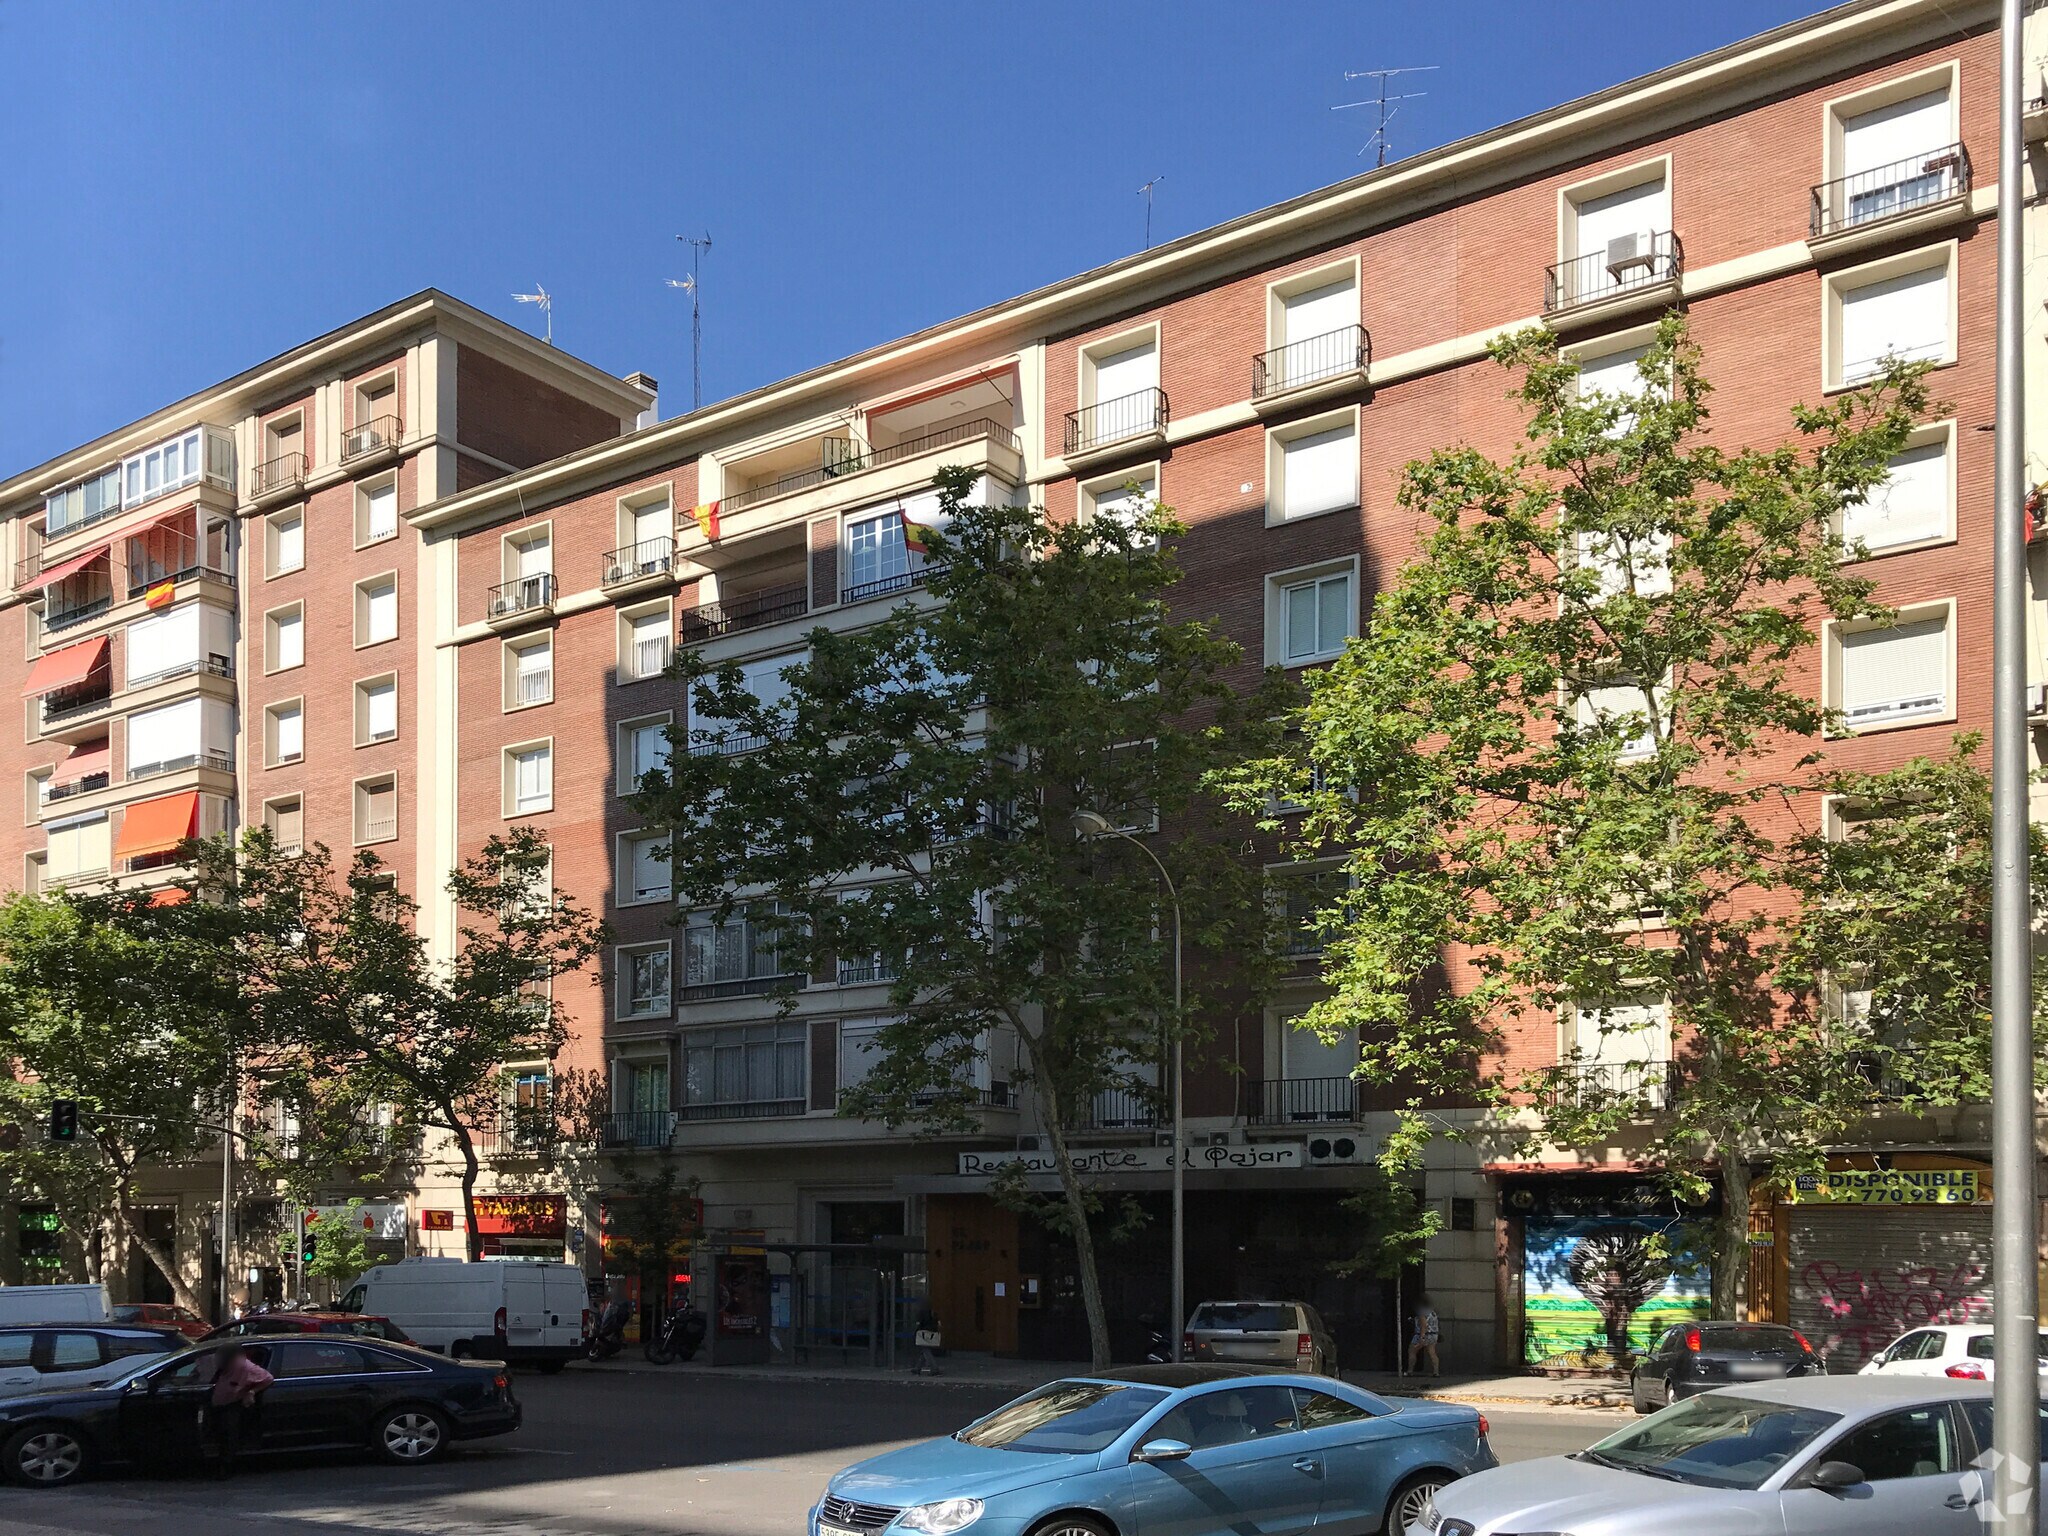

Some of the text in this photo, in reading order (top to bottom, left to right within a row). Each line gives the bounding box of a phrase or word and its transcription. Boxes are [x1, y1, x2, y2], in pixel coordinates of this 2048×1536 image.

[963, 1149, 1147, 1172] Resauante
[1204, 1146, 1293, 1168] Pajar
[1828, 1172, 1974, 1188] DISPONIBLE
[1861, 1188, 1904, 1202] 770
[1910, 1188, 1938, 1202] 98
[1946, 1188, 1975, 1202] 60
[485, 1200, 555, 1216] TABACOS
